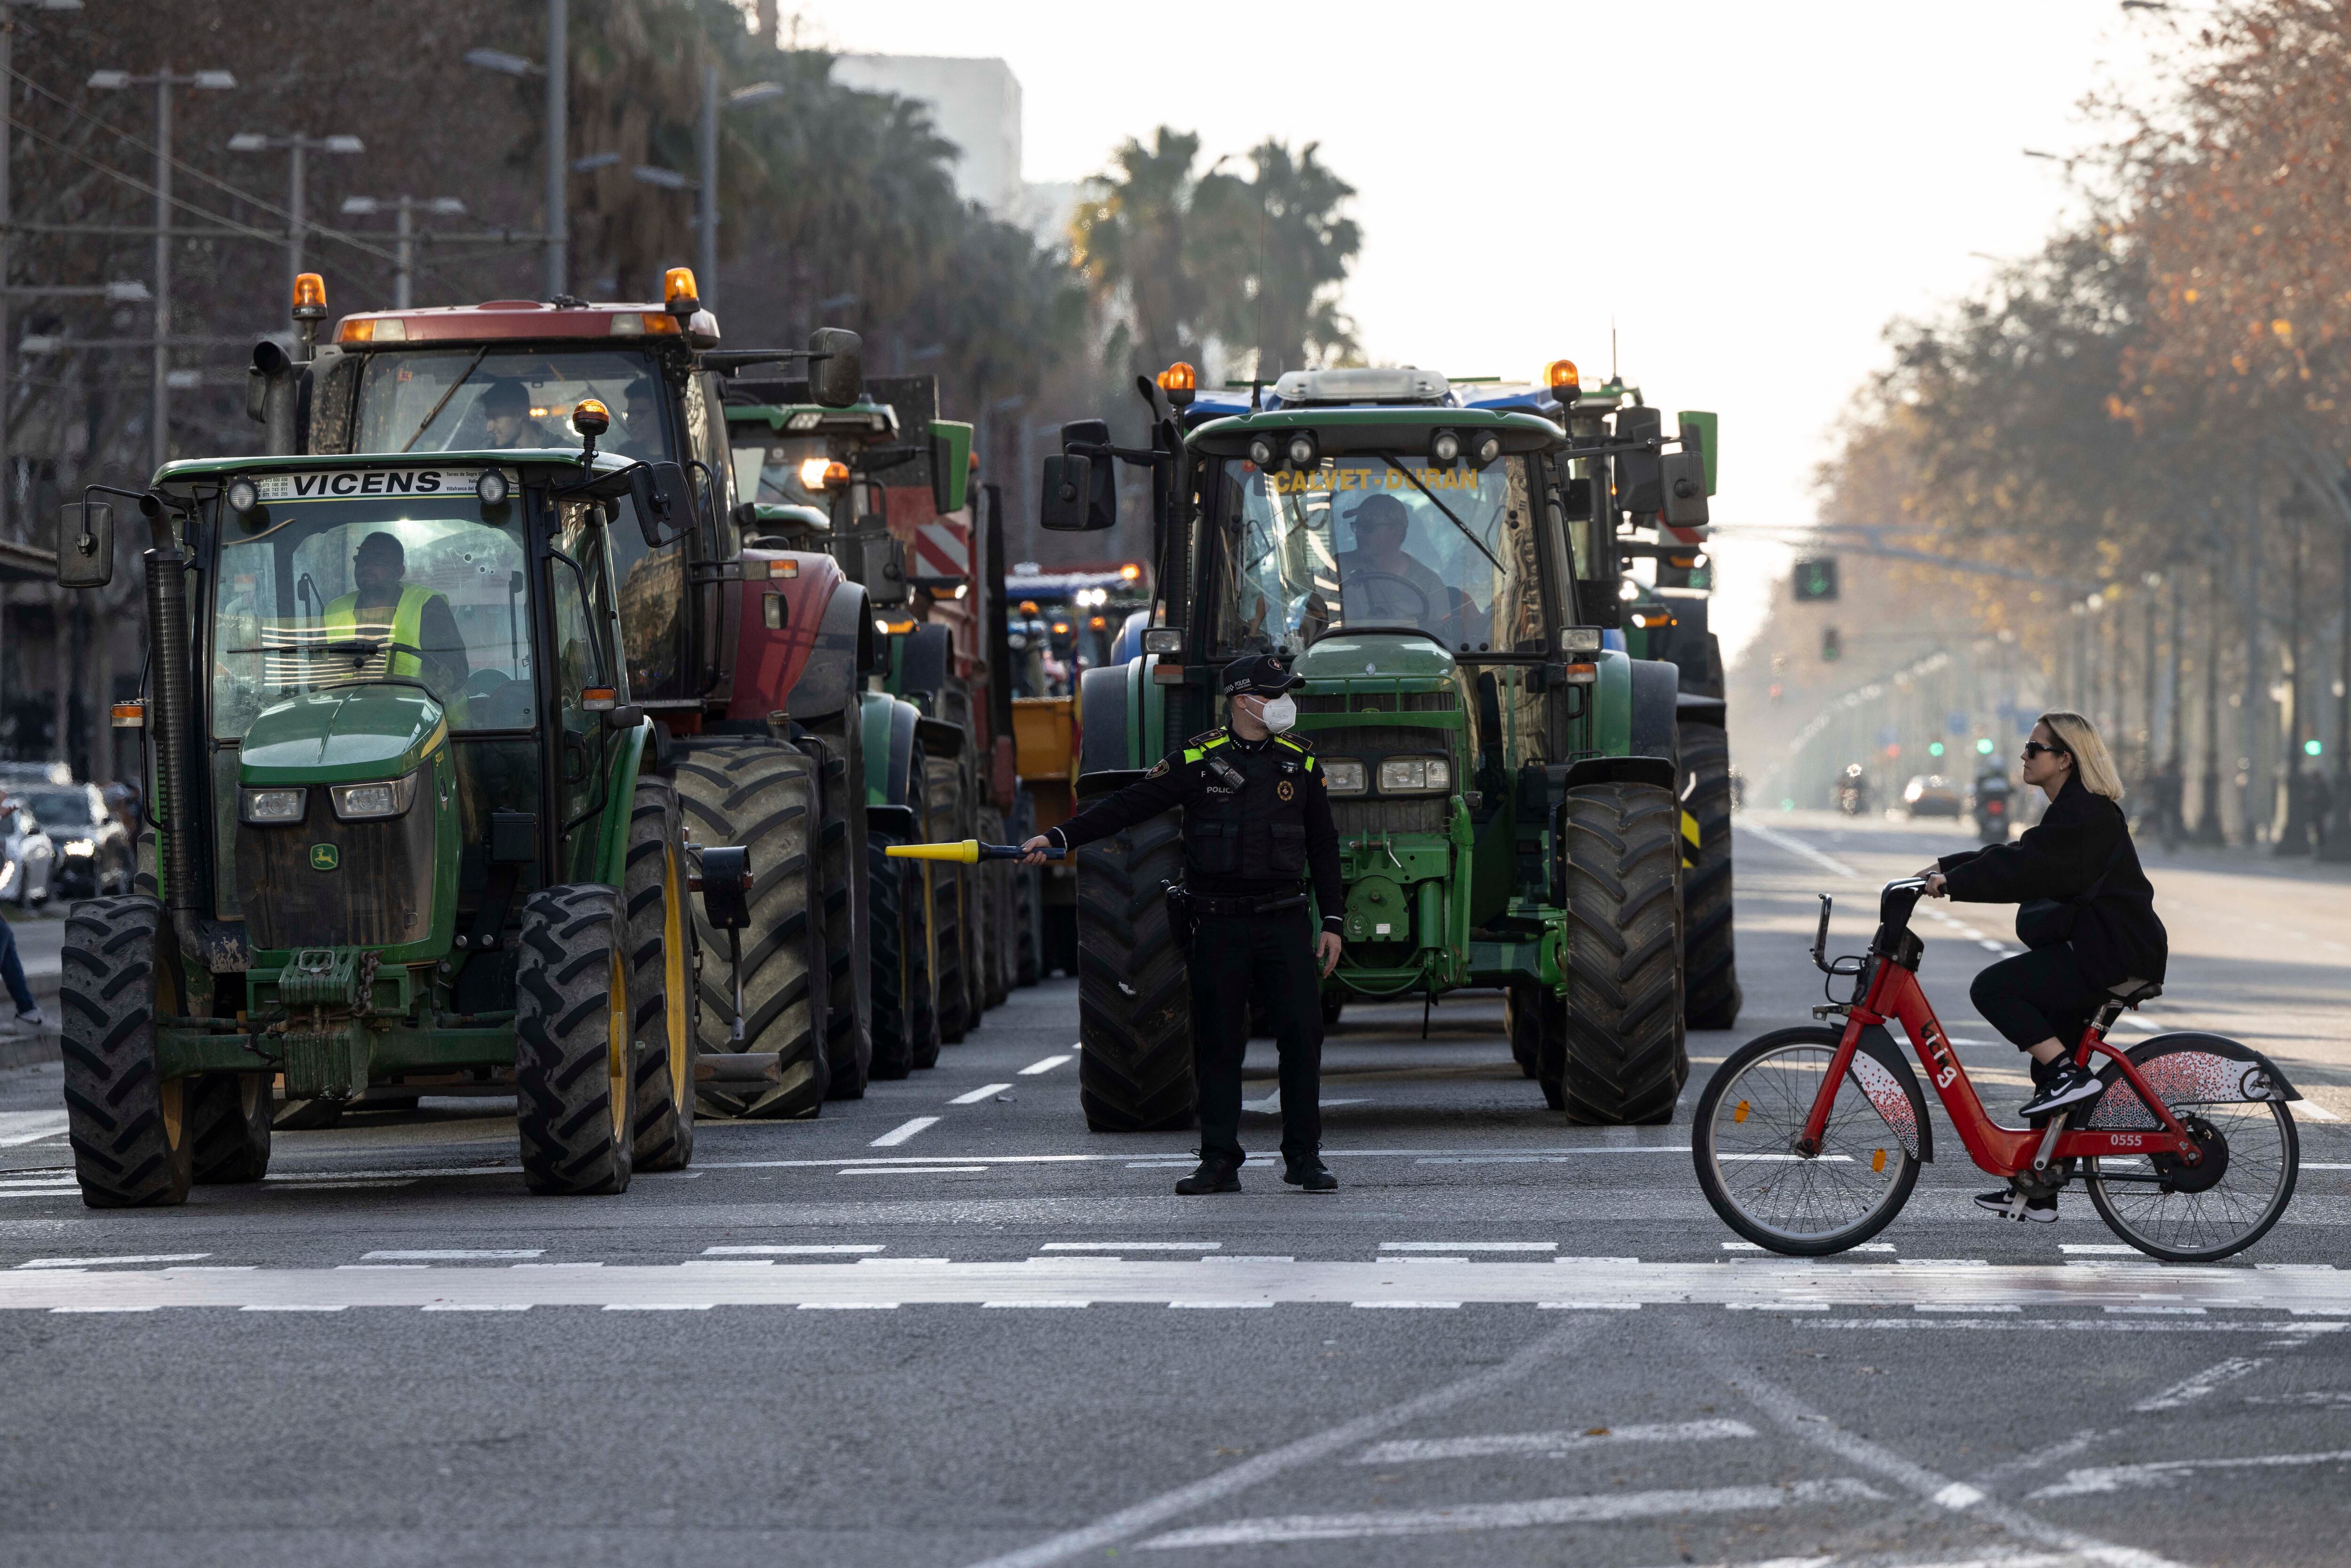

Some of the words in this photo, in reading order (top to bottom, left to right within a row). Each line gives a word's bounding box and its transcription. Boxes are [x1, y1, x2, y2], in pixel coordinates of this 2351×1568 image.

[293, 471, 442, 496] VICENS
[1234, 678, 1251, 687] POLICIA
[1920, 1019, 1957, 1088] bicing
[2110, 1134, 2142, 1146] 0555
